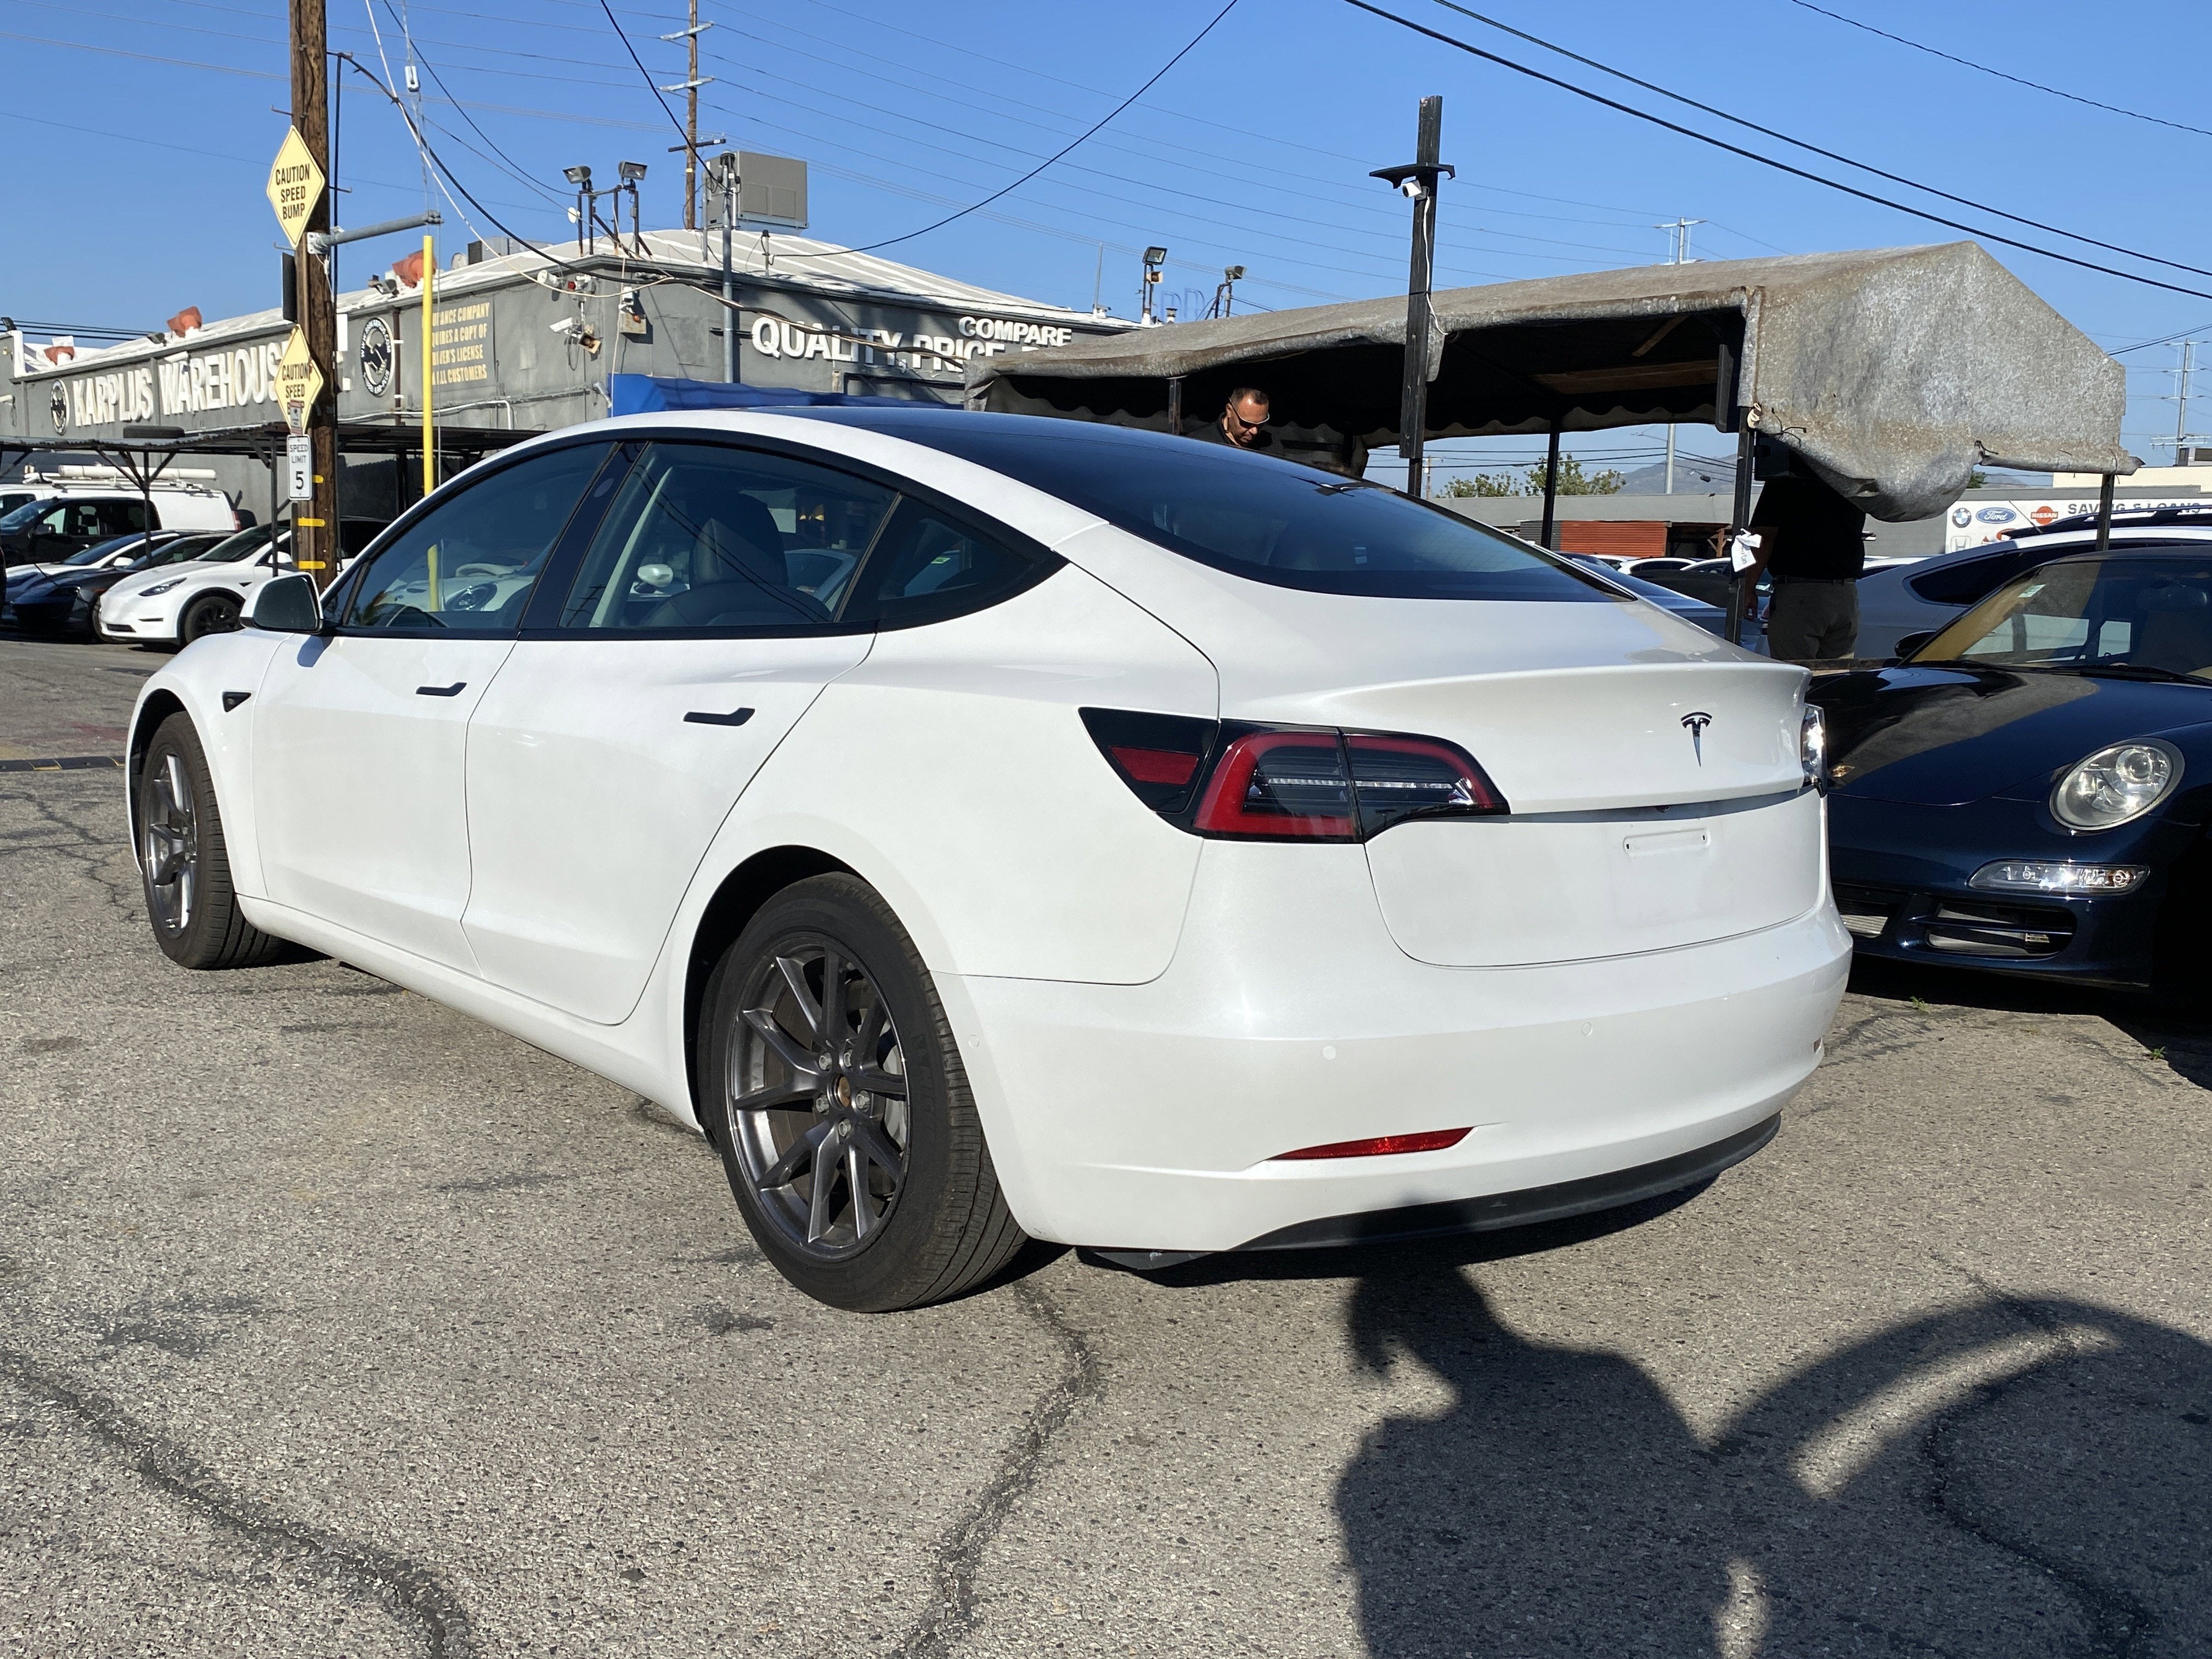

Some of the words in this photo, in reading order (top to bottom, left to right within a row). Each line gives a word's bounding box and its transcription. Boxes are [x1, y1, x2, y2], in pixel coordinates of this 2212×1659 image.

[275, 163, 310, 185] CAUTION
[281, 186, 306, 203] SPEED
[283, 203, 305, 219] BUMP
[458, 302, 490, 322] COMPANY
[454, 328, 459, 342] A
[460, 325, 477, 341] COPY
[478, 323, 487, 338] OF
[959, 316, 1072, 347] COMPARE
[432, 348, 455, 366] RIVER'S
[456, 344, 483, 362] LICENSE
[282, 362, 309, 381] CAUTION
[447, 364, 487, 383] CUSTOMERS
[72, 368, 154, 427] KARPLUS
[159, 341, 289, 415] WAREHOUS
[286, 384, 304, 398] SPEED
[289, 444, 308, 453] SPEED
[291, 455, 306, 464] LIMIT
[295, 471, 304, 489] 5
[1984, 510, 2008, 520] Ford
[2068, 503, 2125, 514] SAVG
